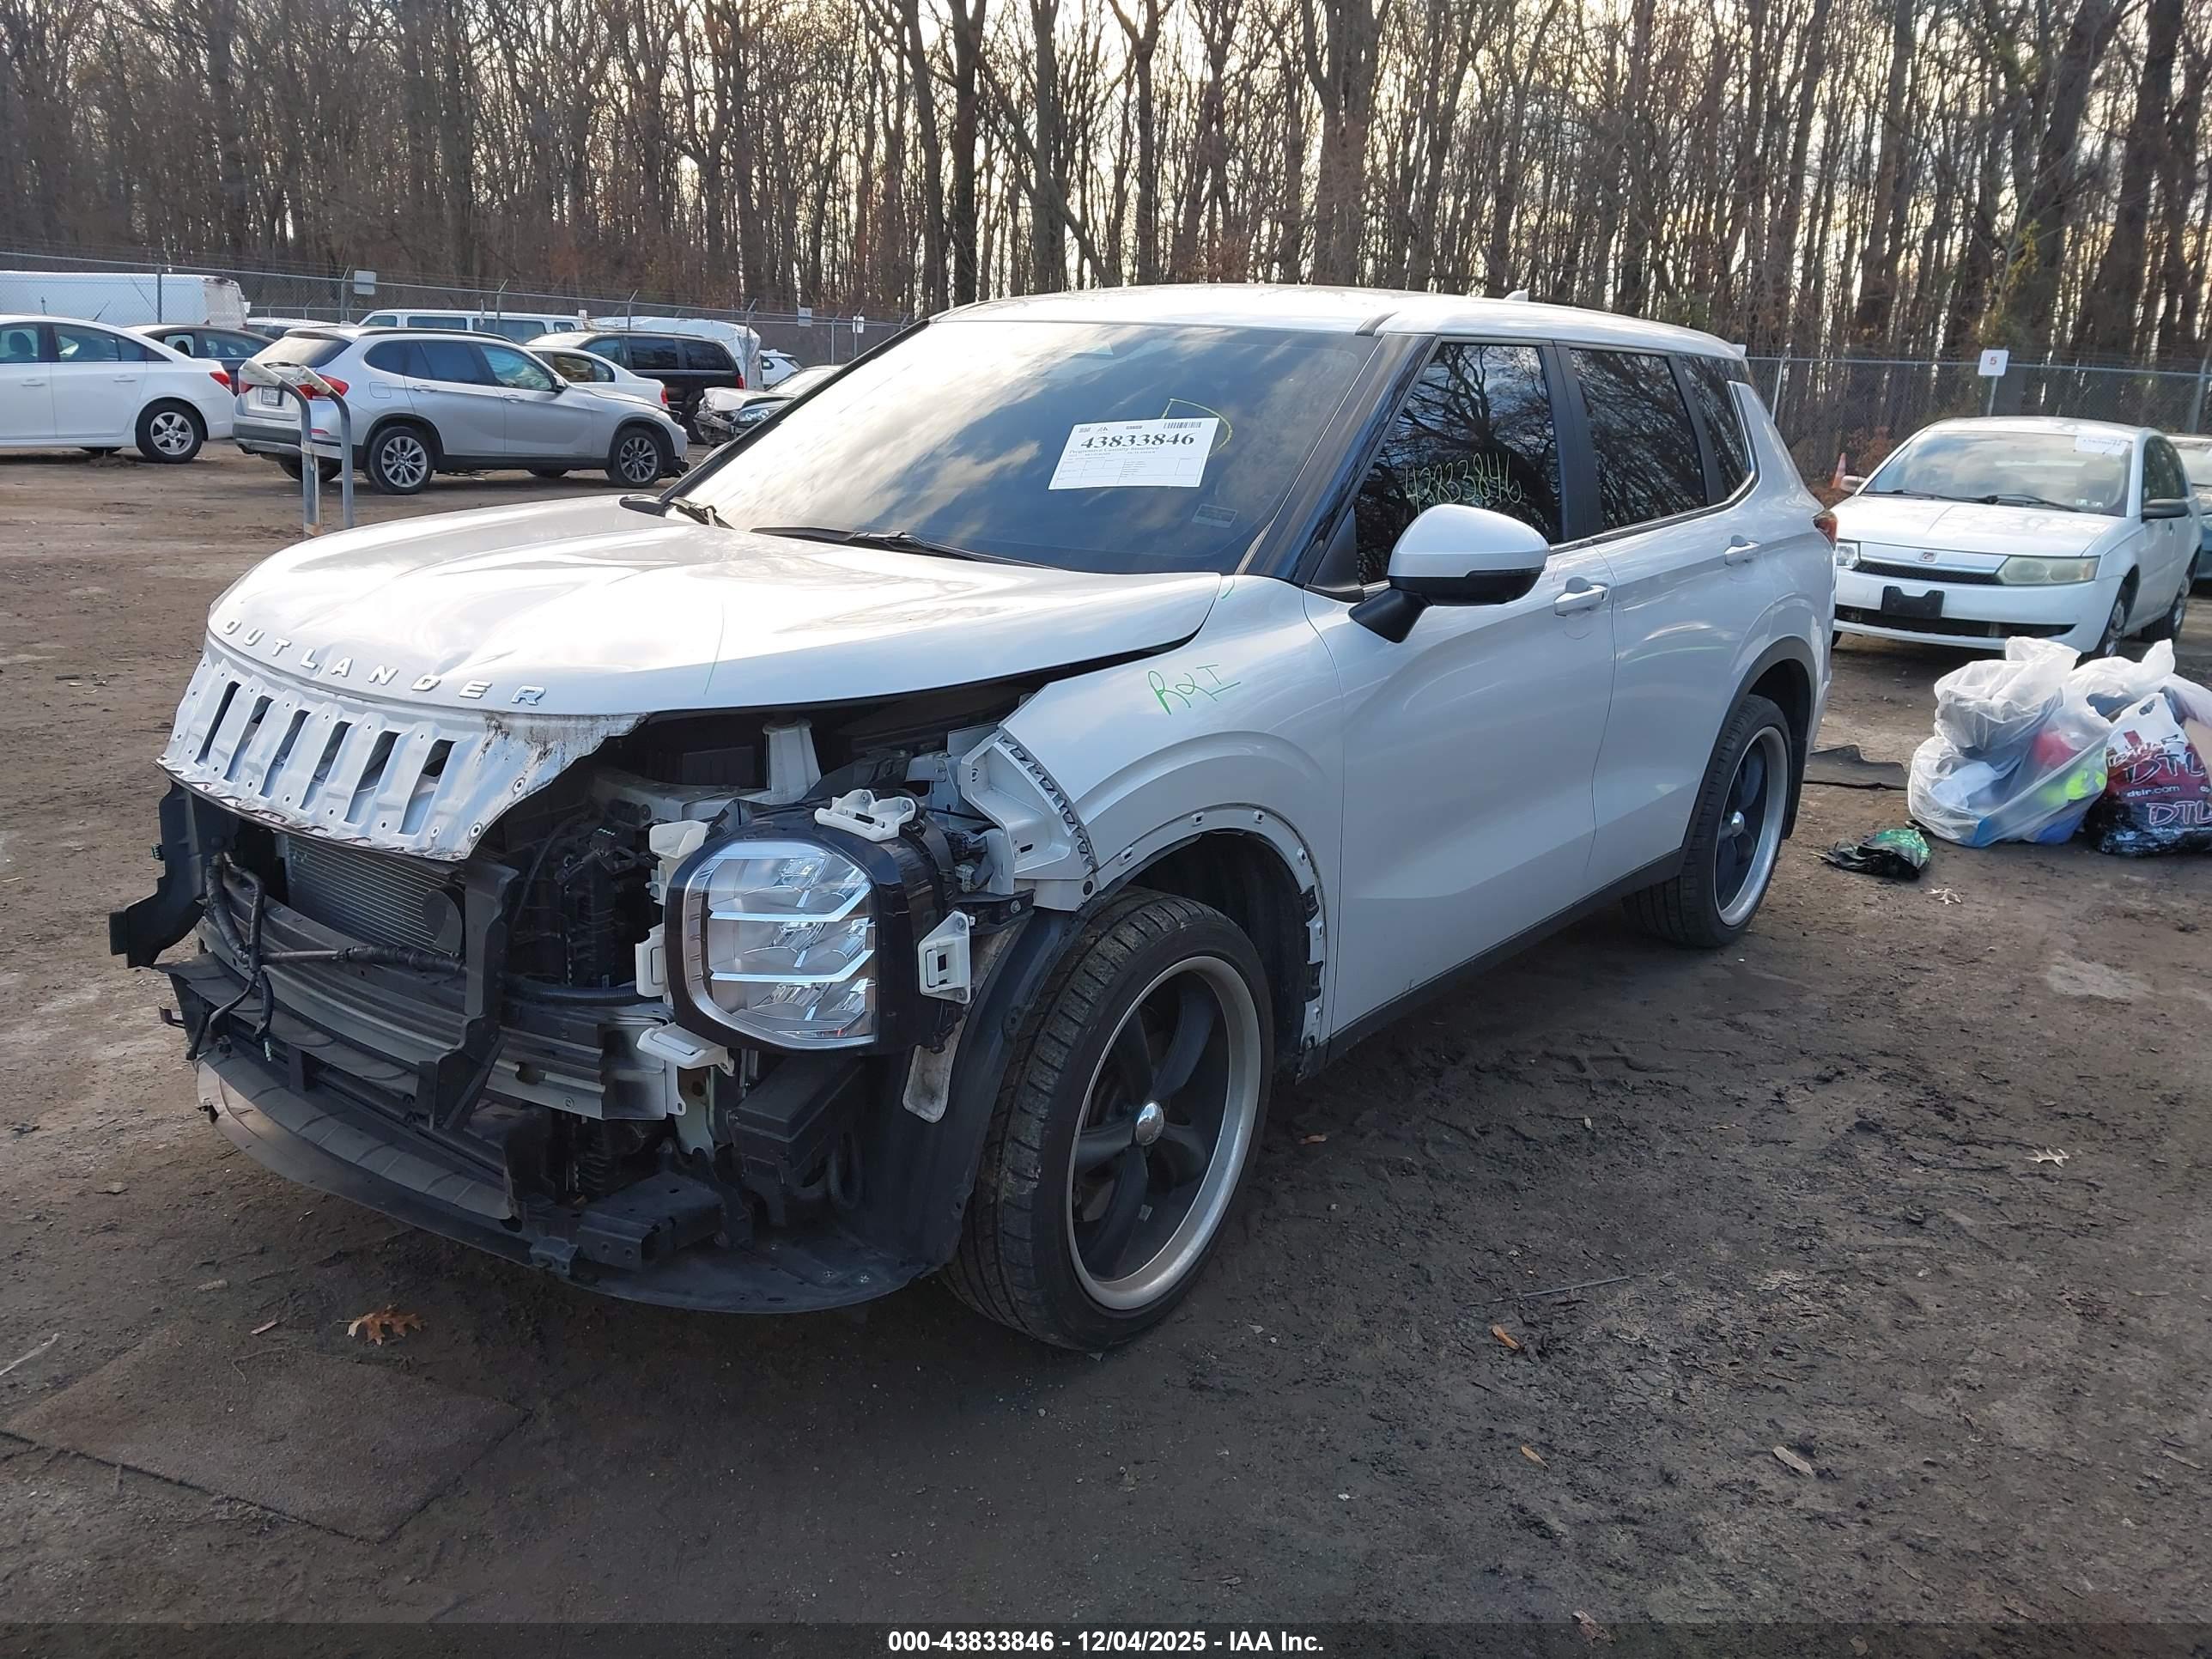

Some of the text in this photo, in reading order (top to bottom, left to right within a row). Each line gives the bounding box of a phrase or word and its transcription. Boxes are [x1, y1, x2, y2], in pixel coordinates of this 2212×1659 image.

[1989, 356, 1998, 366] 5
[1080, 432, 1196, 449] 43833846
[222, 617, 547, 706] OUTLANDER
[2126, 785, 2180, 798] dtlr.com
